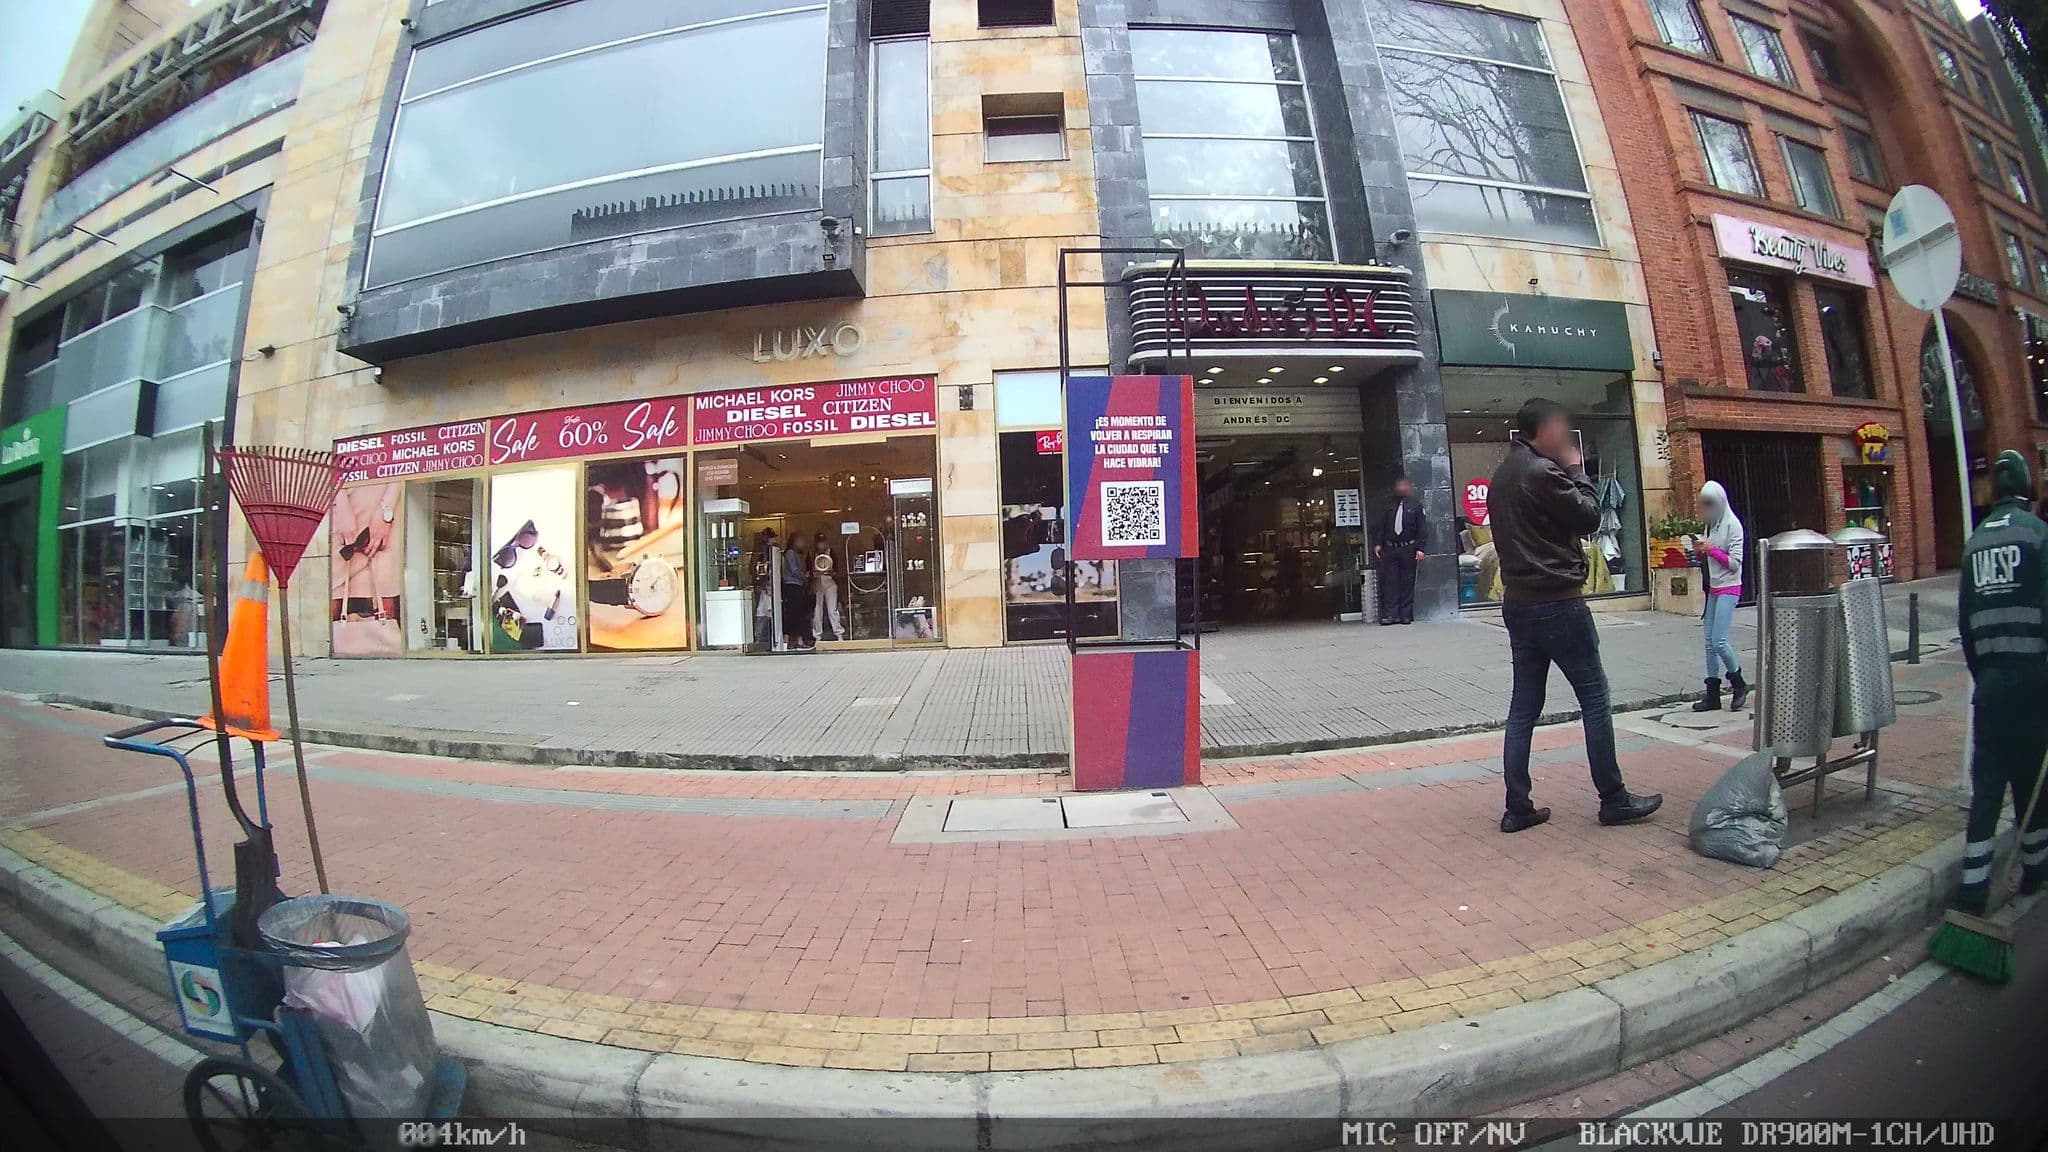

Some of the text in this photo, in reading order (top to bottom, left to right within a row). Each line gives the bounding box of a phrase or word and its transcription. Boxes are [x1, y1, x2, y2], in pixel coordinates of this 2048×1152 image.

[1749, 225, 1848, 275] Beauty Vibes
[753, 321, 863, 363] LUXO
[1510, 323, 1597, 337] KAMUCHY
[696, 378, 925, 410] MICHAEL KORS JIMMY CHOO
[1214, 397, 1291, 405] BIENVENIDOS
[727, 397, 893, 423] DIESEL CITIZEN
[1110, 416, 1153, 427] MOMENTO
[1155, 416, 1167, 426] DE
[337, 422, 486, 454] DIESEL FOSSIL CITIZEN
[559, 420, 608, 448] 60%
[622, 402, 679, 451] Sale
[696, 412, 936, 442] JIMMY CHOO FOSSIL DIESEL
[1090, 429, 1173, 441] VOLVER A RESPIRAR
[360, 452, 387, 466] CHOO
[392, 445, 439, 461] MICHAEL
[443, 440, 476, 455] KORS
[491, 418, 540, 464] Sale
[1095, 443, 1169, 455] LA CIUDAD QUE TE
[377, 460, 420, 478] CITIZEN
[423, 459, 450, 472] JIMMY
[451, 454, 483, 469] CHOO
[1103, 458, 1126, 468] HACE
[1972, 545, 2021, 587] UAESP
